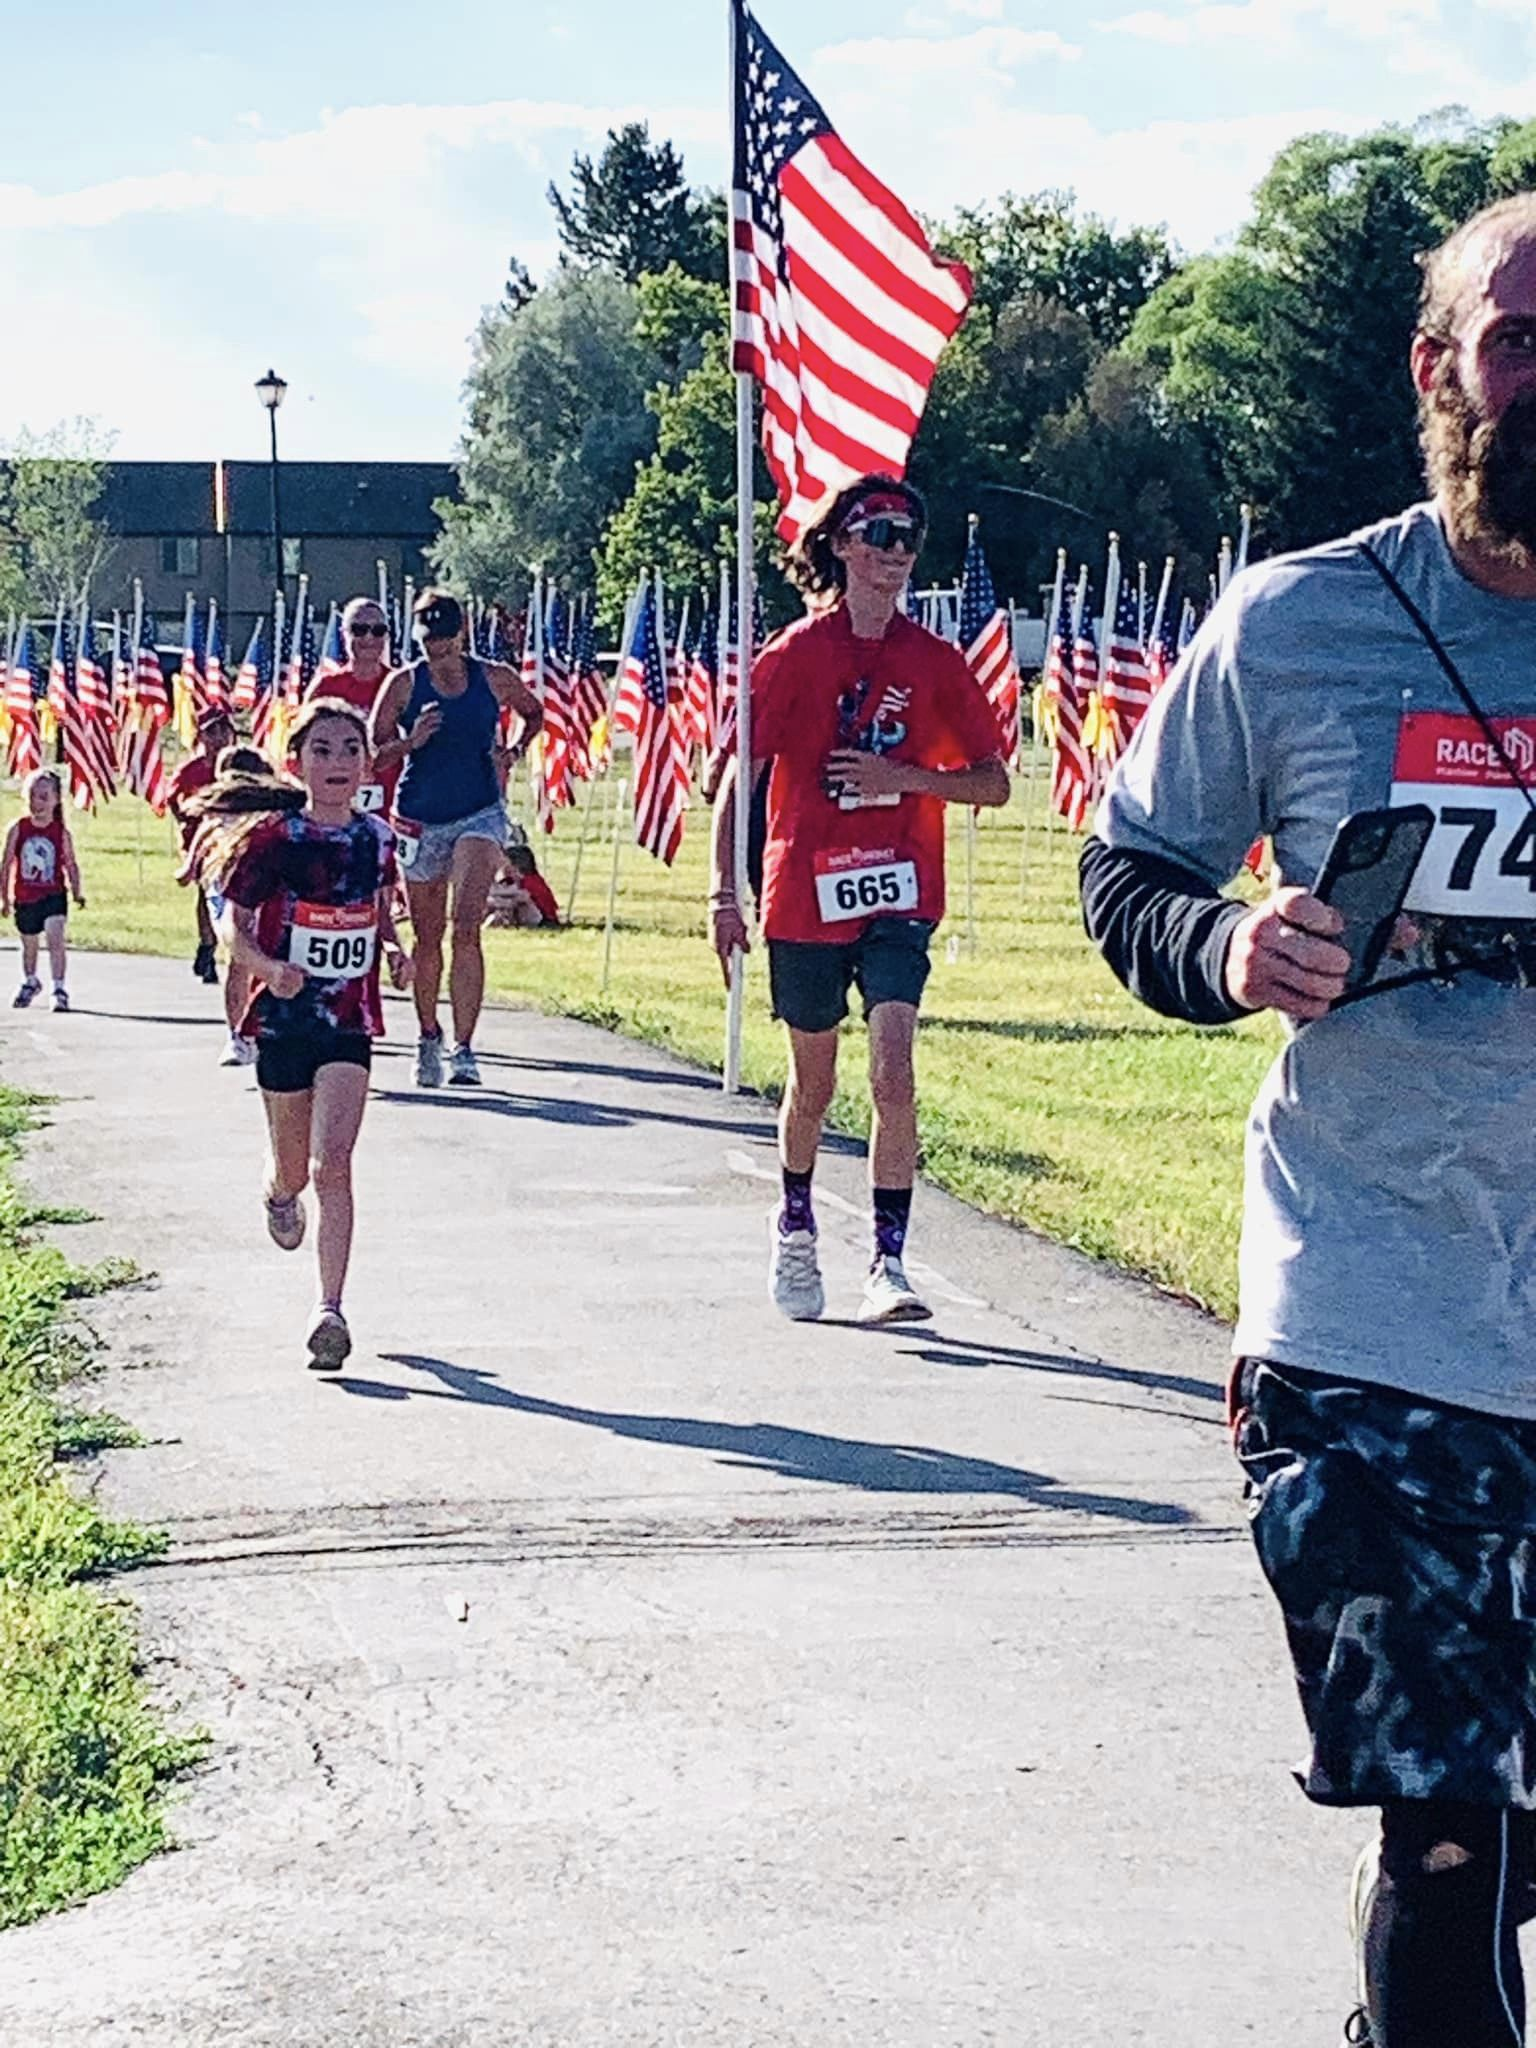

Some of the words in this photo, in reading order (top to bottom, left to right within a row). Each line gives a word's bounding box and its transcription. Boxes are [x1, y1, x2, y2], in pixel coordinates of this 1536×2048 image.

[1437, 738, 1501, 767] RACE
[836, 871, 901, 910] 665
[307, 937, 367, 969] 509
